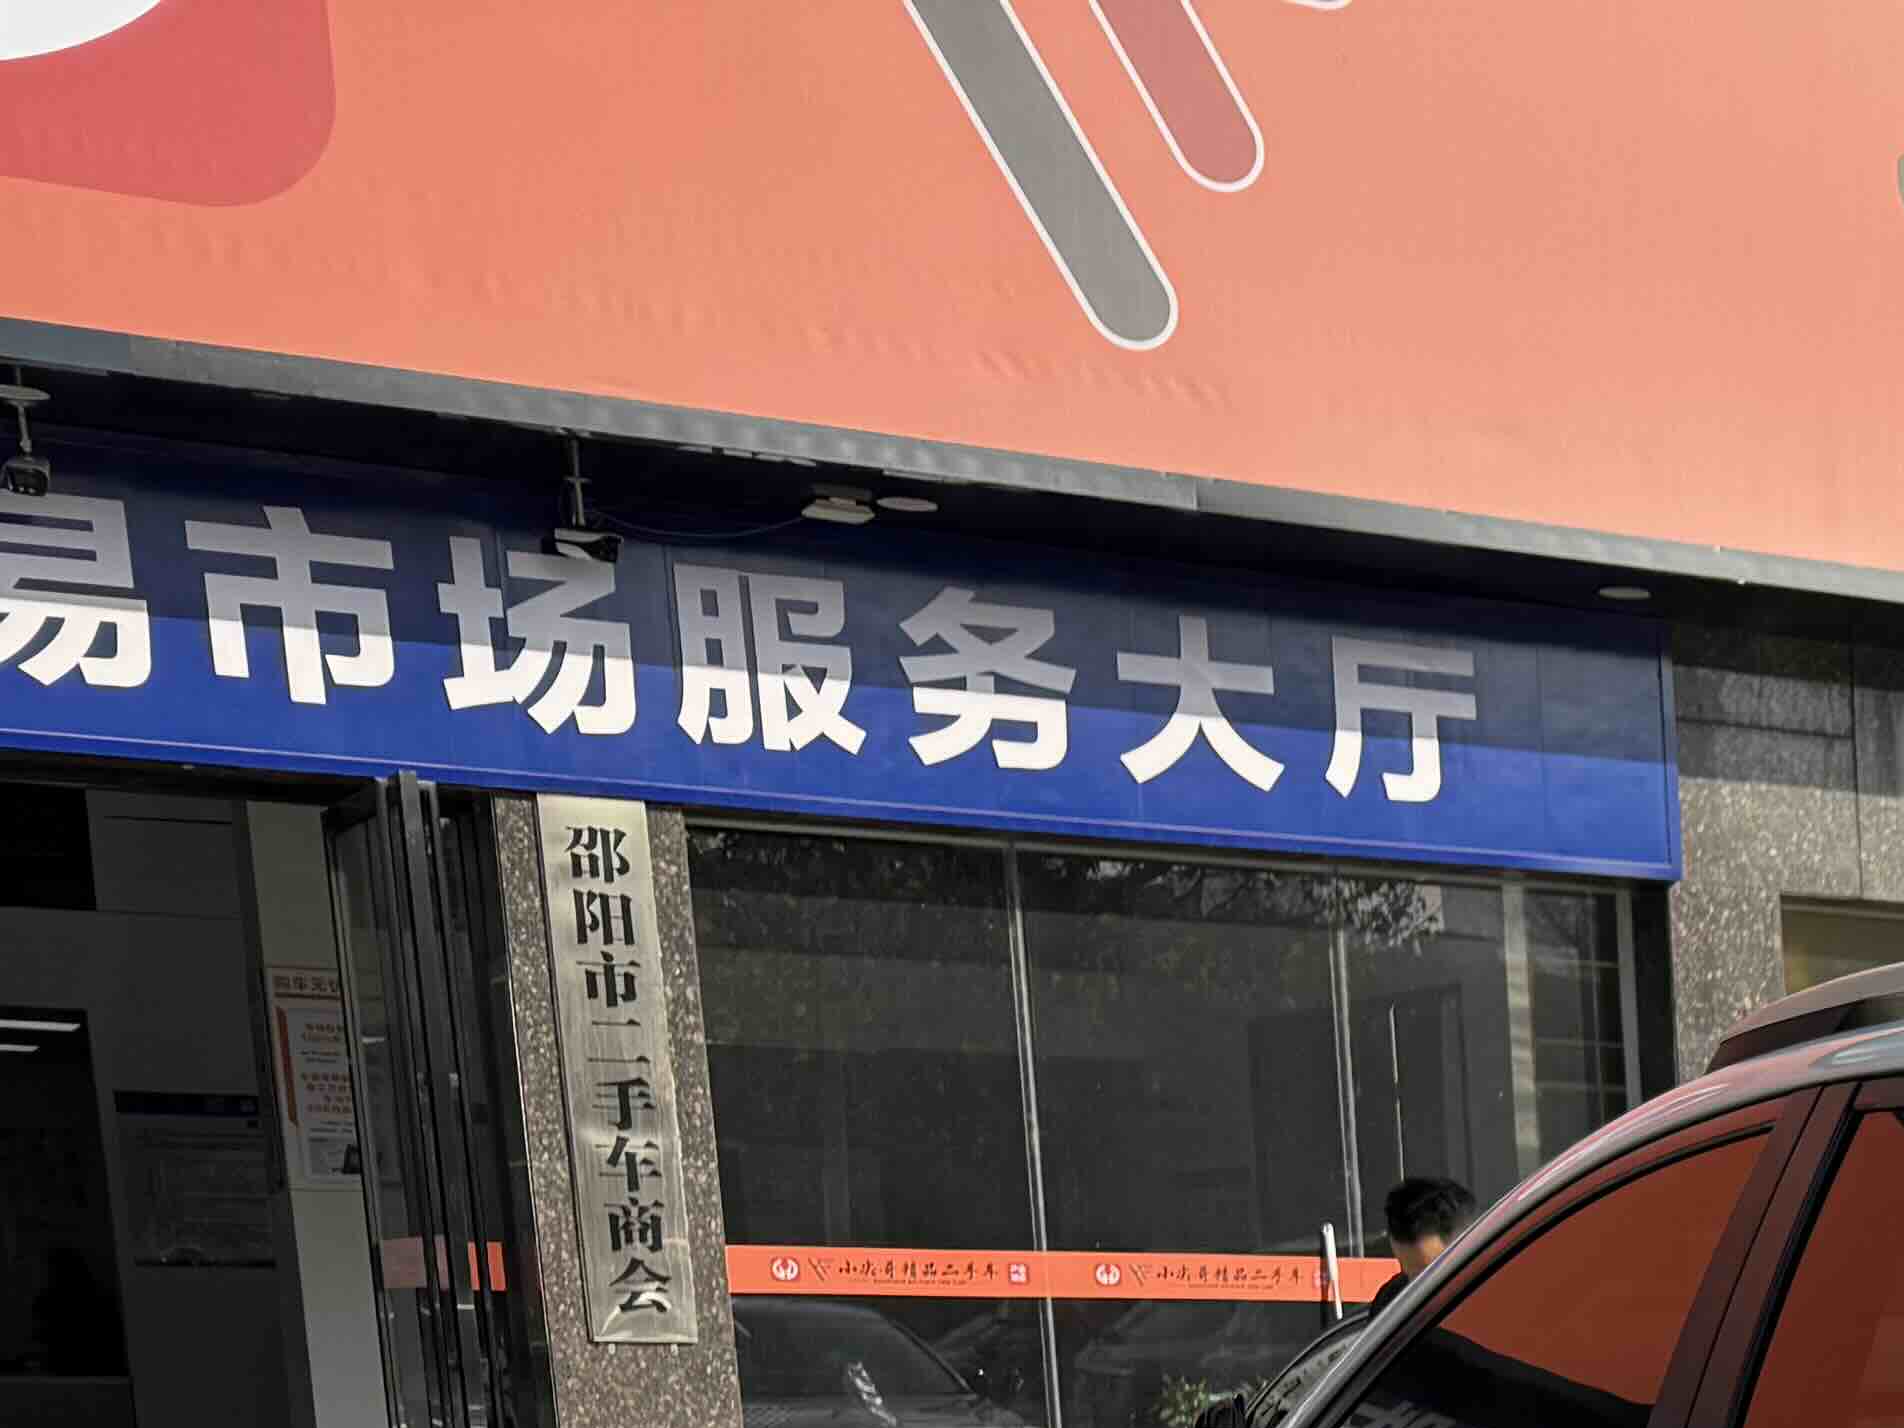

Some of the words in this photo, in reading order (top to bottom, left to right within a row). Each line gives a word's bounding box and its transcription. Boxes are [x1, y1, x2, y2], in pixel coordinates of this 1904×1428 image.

[0, 492, 1478, 803] 易市场服务大厅
[565, 825, 672, 1313] 邵阳市二手车商会
